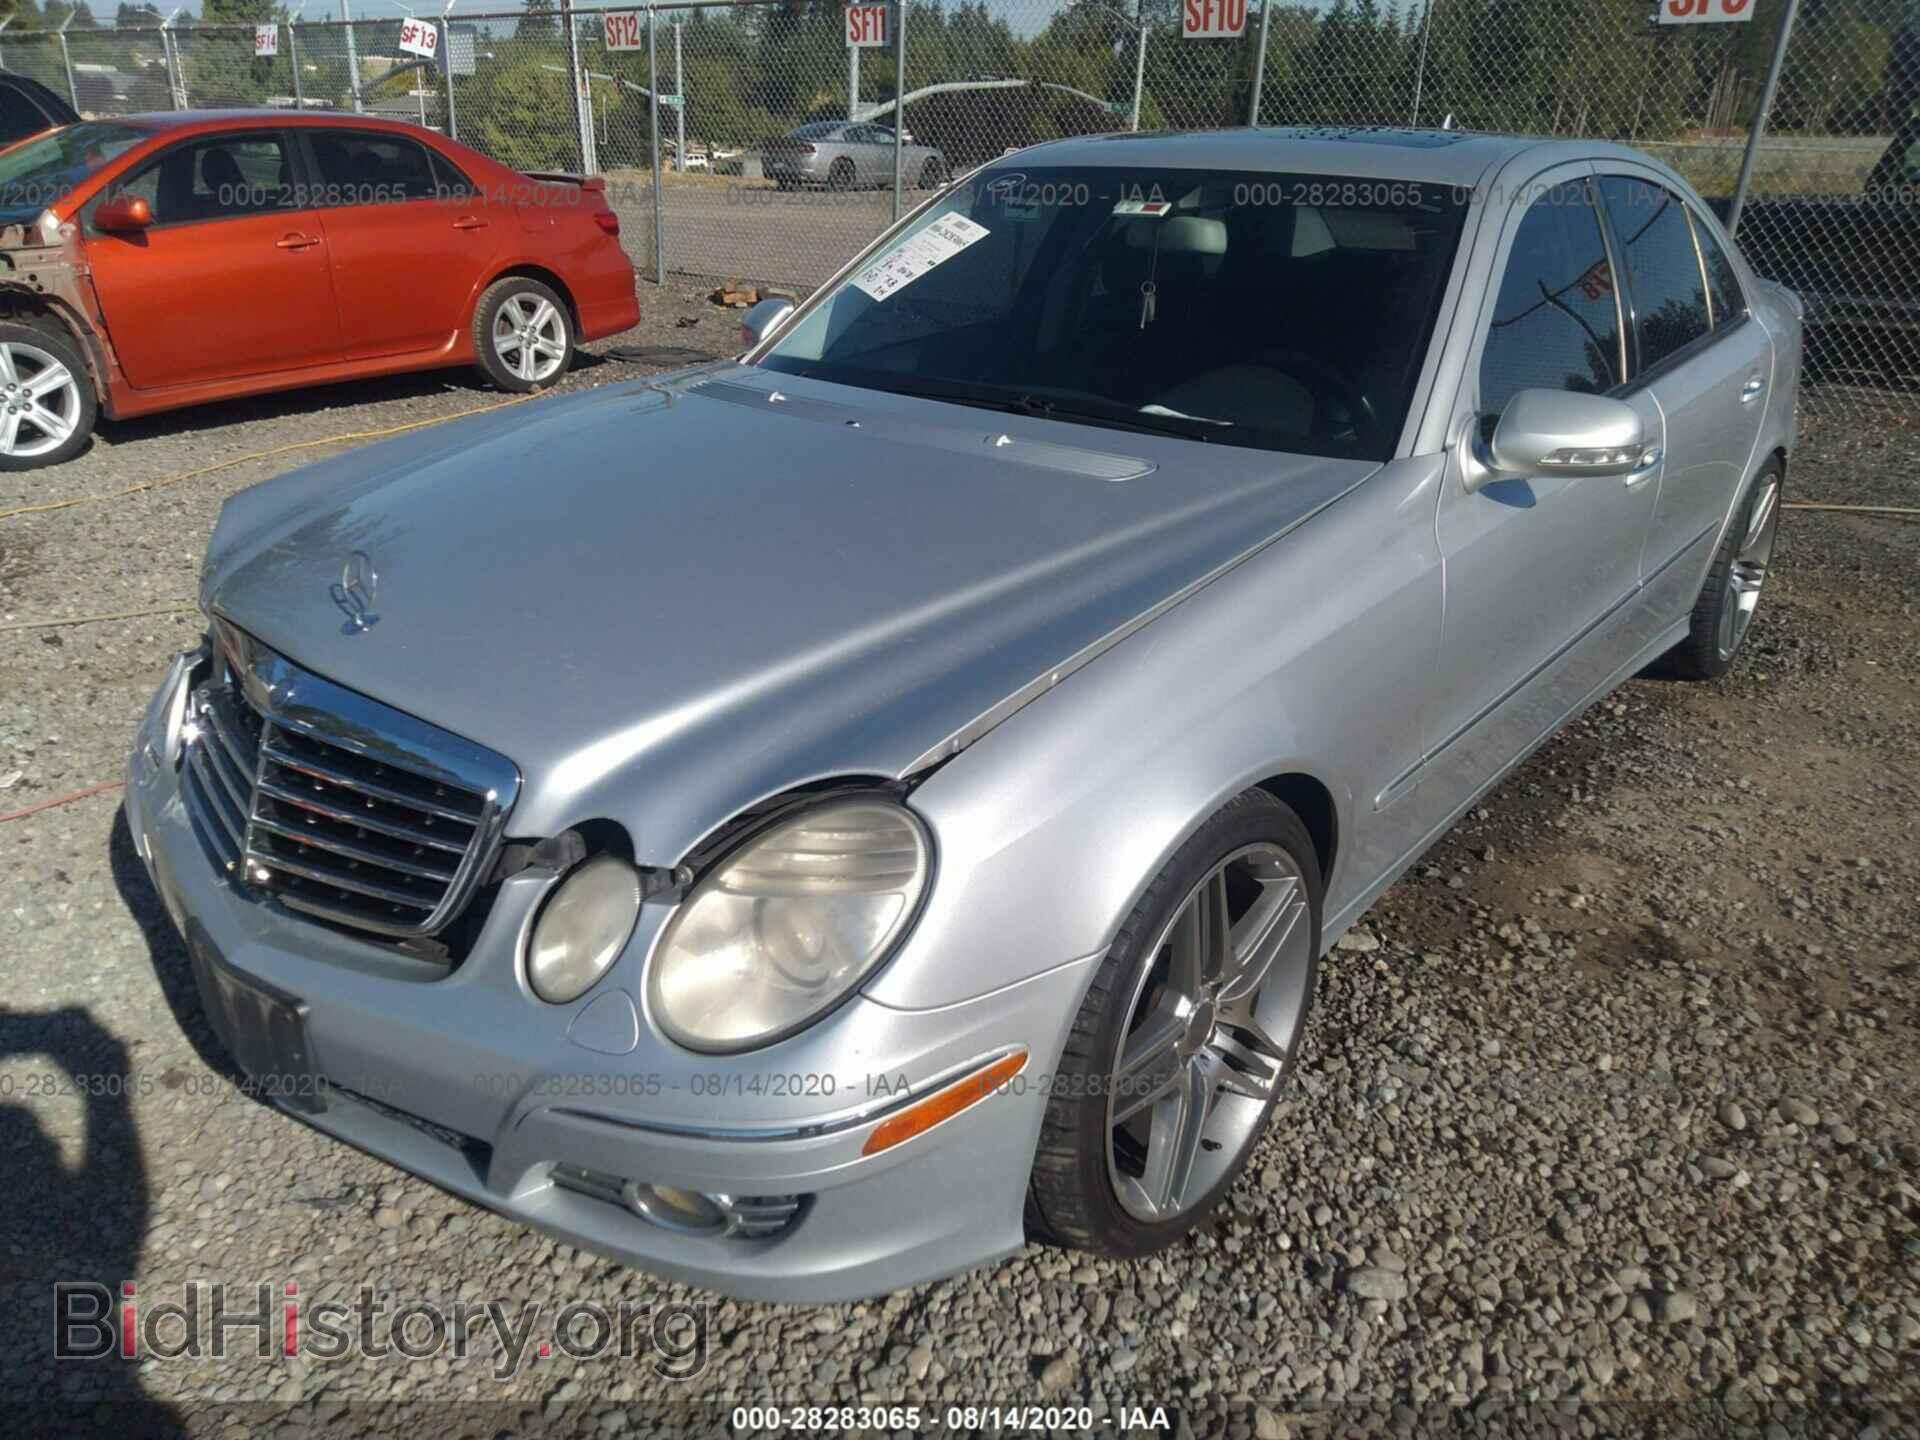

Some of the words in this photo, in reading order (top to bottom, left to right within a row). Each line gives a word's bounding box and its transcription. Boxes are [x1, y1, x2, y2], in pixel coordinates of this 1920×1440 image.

[606, 15, 639, 47] SF12
[849, 7, 885, 42] SF11
[1186, 0, 1244, 32] SF10
